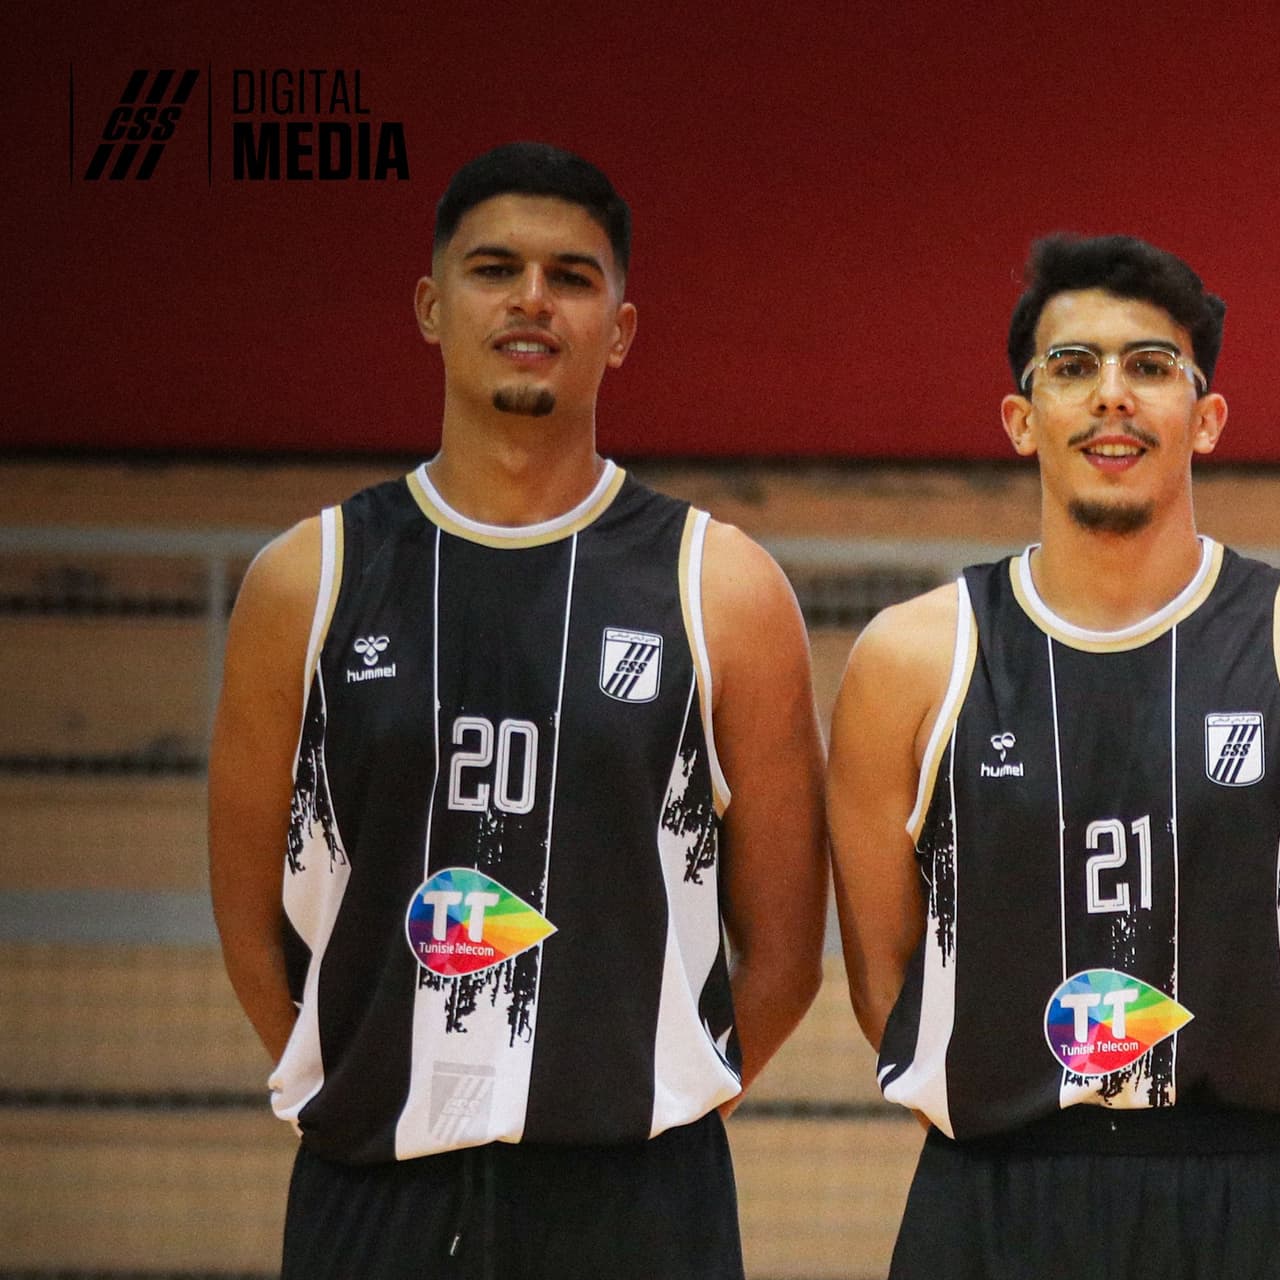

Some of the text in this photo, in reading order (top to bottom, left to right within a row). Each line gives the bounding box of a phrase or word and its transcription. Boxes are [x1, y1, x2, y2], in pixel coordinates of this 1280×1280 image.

[346, 662, 397, 683] hummel
[615, 660, 648, 675] CSS
[1220, 743, 1251, 757] CSS
[447, 716, 539, 815] 20
[980, 762, 1024, 777] humel
[1085, 814, 1153, 915] 21
[423, 890, 500, 943] TT
[419, 942, 494, 957] Tunisie Telecom
[1060, 988, 1139, 1043] TT
[1060, 1040, 1139, 1057] Tunisie Telecom
